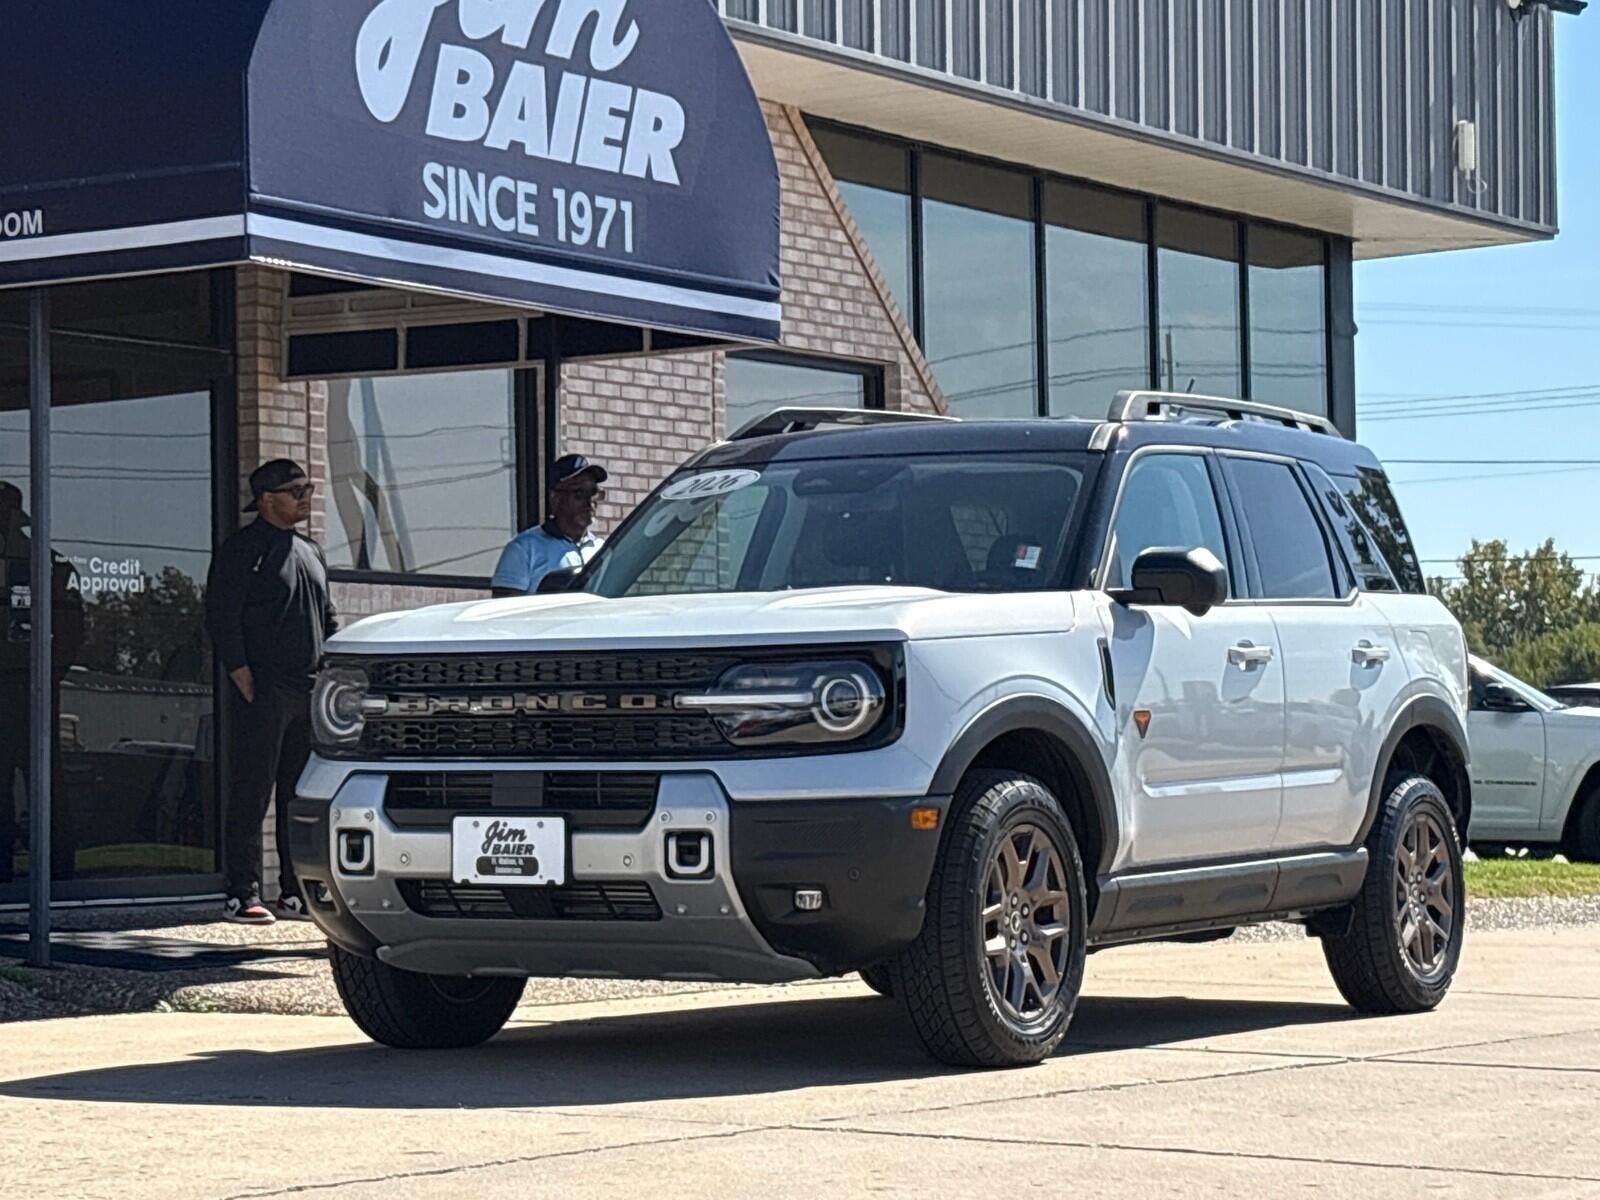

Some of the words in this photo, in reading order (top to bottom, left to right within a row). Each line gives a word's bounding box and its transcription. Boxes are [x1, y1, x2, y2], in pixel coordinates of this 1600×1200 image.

[425, 43, 685, 186] BAIER
[422, 162, 539, 236] SINCE
[552, 188, 634, 253] 1971
[0, 209, 43, 237] OM
[89, 557, 141, 575] Credit
[65, 572, 145, 595] Approval
[399, 694, 657, 712] BRONCO
[481, 820, 528, 854] Jim
[491, 843, 535, 855] BAIER
